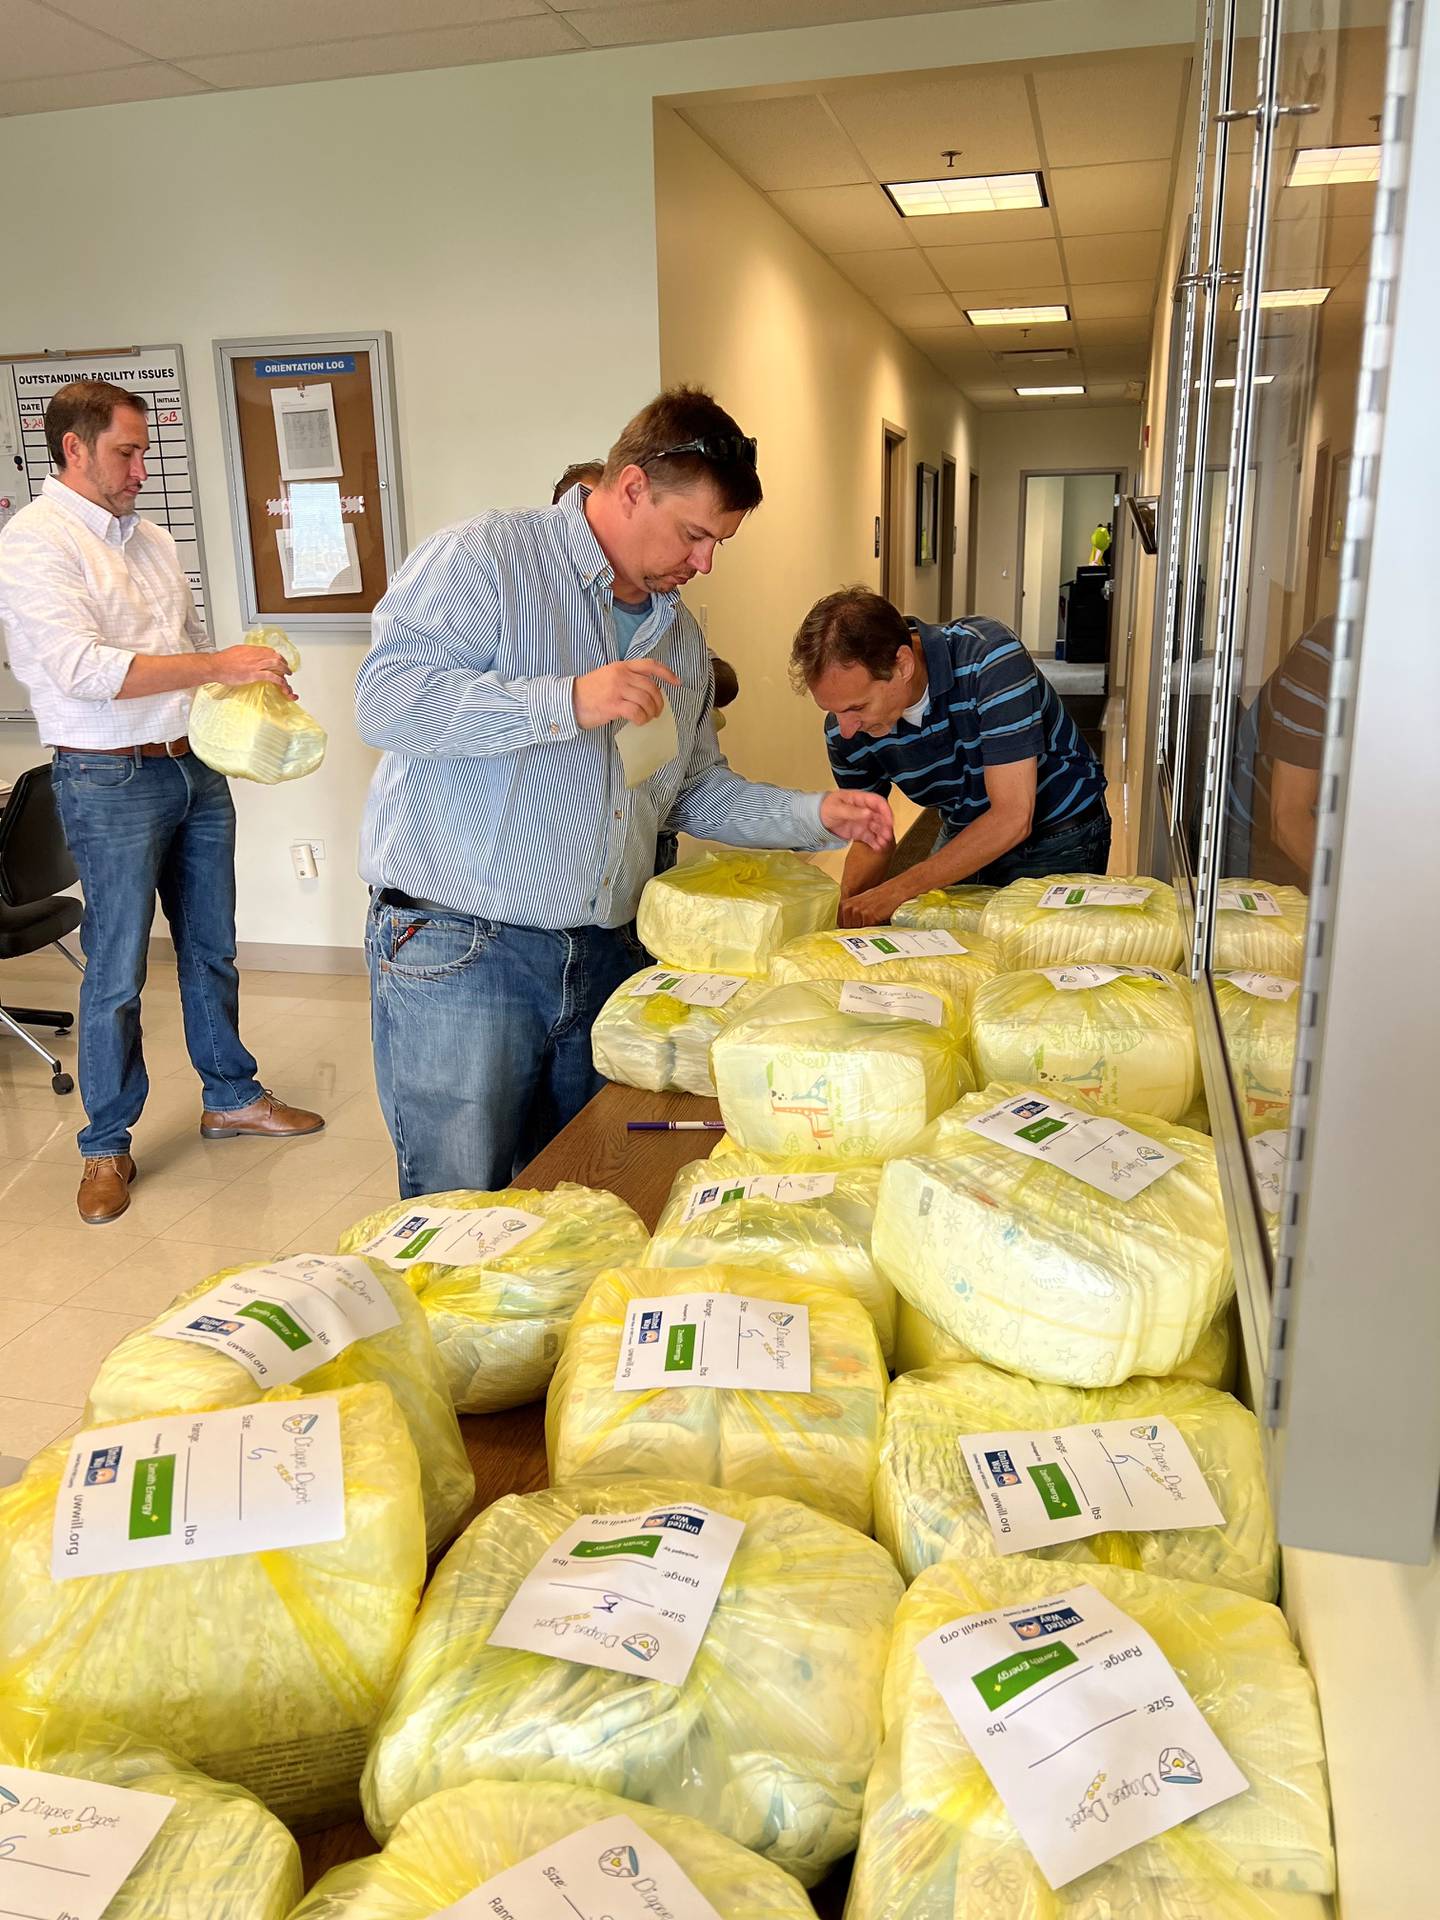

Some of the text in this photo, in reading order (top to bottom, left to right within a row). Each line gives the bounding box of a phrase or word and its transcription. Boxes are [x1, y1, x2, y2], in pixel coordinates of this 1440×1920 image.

[18, 368, 175, 384] OUTSTANDING FACILITY ISSUES
[265, 360, 345, 373] ORIENTATION LOG
[20, 403, 41, 411] DATE
[269, 1313, 292, 1336] Energy
[740, 1328, 765, 1339] 5
[316, 1331, 331, 1346] lbs
[226, 1340, 268, 1375] uwwill.org
[700, 1366, 710, 1377] lbs
[991, 1460, 1002, 1473] Way
[997, 1451, 1013, 1472] United
[142, 1485, 156, 1516] Energy
[1047, 1481, 1061, 1504] Energy
[591, 1515, 642, 1527] uwwill.org
[670, 1514, 689, 1524] Way
[990, 1492, 1012, 1534] uwwill.org
[1090, 1506, 1102, 1520] lbs
[66, 1494, 83, 1556] uwwill.org
[184, 1524, 198, 1546] lbs
[666, 1520, 700, 1534] United
[551, 1557, 700, 1588] Range: lbs
[657, 1608, 687, 1624] Size:
[1039, 1613, 1063, 1624] Way
[1044, 1615, 1081, 1633] United
[939, 1617, 998, 1645] uwwill.org
[996, 1649, 1061, 1683] Zenith Energy
[986, 1645, 1143, 1737] Range: lbs
[1143, 1695, 1175, 1715] Size:
[75, 1805, 121, 1828] Depot
[1065, 1799, 1110, 1832] Depot
